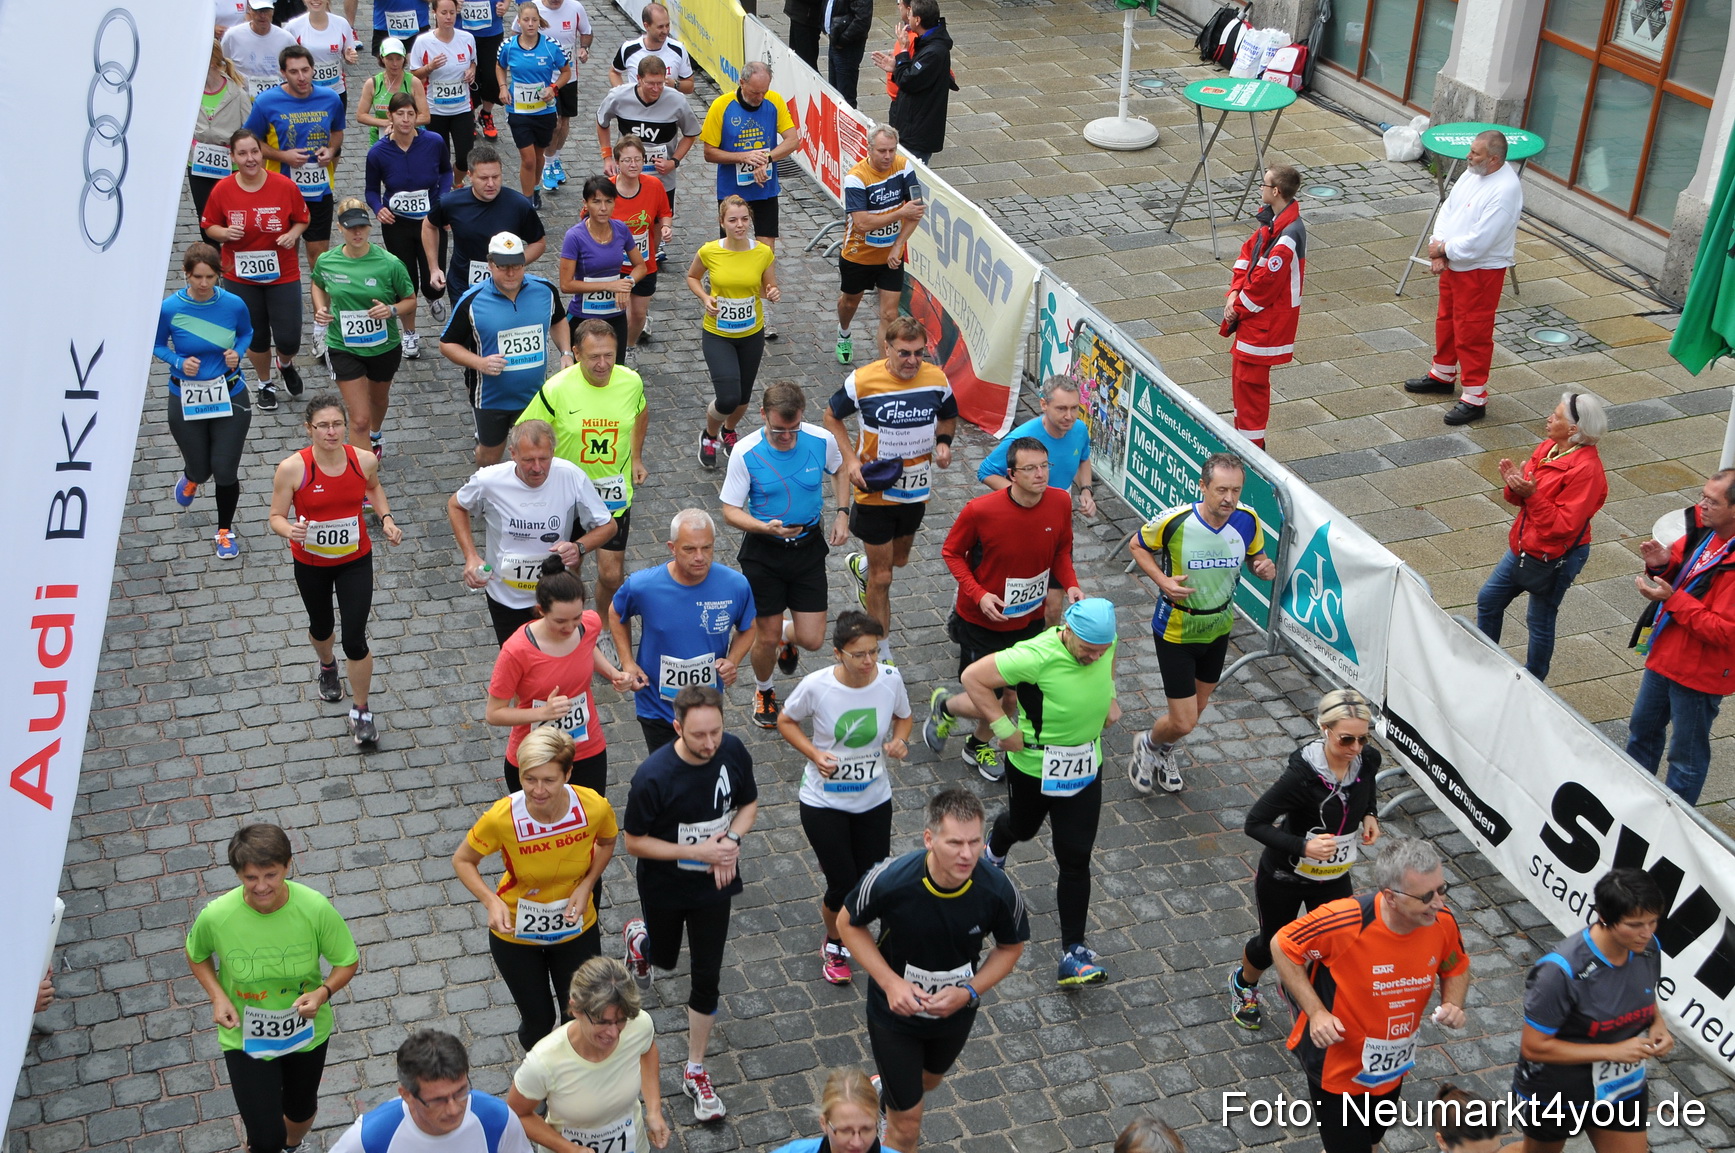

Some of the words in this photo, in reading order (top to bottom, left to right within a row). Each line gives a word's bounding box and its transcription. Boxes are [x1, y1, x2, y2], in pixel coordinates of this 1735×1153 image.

[464, 8, 489, 20] 3423
[390, 18, 414, 29] 2547
[313, 66, 338, 80] 2895
[437, 85, 463, 98] 2944
[520, 90, 540, 102] 174
[631, 123, 660, 142] sky
[197, 151, 229, 168] 2485
[295, 170, 326, 184] 2384
[394, 199, 426, 212] 2385
[240, 259, 275, 275] 2306
[721, 305, 752, 320] 2589
[910, 247, 990, 371] PFLASTERSTEINE
[347, 319, 382, 335] 2309
[504, 336, 541, 355] 2533
[510, 355, 538, 364] Bernhard
[185, 386, 222, 404] 2717
[194, 405, 220, 413] Daniela
[886, 400, 934, 420] Fischer
[582, 418, 620, 427] Müller
[590, 438, 609, 455] M
[899, 449, 911, 457] und
[1133, 425, 1165, 466] Mehr
[1166, 452, 1204, 503] Sicher
[892, 472, 928, 489] 175
[1131, 450, 1149, 480] für
[1150, 466, 1167, 496] Ihr
[1129, 485, 1145, 508] Miet
[1146, 500, 1153, 517] &
[509, 517, 546, 530] Allianz
[316, 529, 349, 545] 608
[1190, 549, 1224, 558] TEAM
[1187, 556, 1240, 570] BOCK
[10, 584, 79, 811] Audi
[45, 338, 106, 540] BKK
[1010, 580, 1044, 605] 2523
[1283, 617, 1313, 646] Gebäude
[1312, 639, 1338, 664] Service
[1337, 658, 1360, 682] GmbH
[661, 660, 679, 669] PARTL
[680, 660, 707, 669] Neumarkt
[665, 666, 712, 687] 2068
[538, 706, 585, 730] 359
[829, 759, 877, 781] 2257
[1048, 755, 1092, 777] 2741
[1055, 780, 1085, 790] Andreas
[1431, 762, 1448, 785] die
[1448, 778, 1497, 836] verbinden
[519, 842, 552, 855] MAX
[555, 831, 590, 849] BÖGL
[519, 903, 541, 913] PARTL
[906, 970, 929, 981] PARTL
[930, 974, 964, 983] Neumarkt
[1372, 973, 1432, 991] SportScheck
[245, 1010, 269, 1019] PARTL
[251, 1014, 308, 1038] 3394
[1390, 1021, 1412, 1036] GfK
[1365, 1043, 1389, 1051] PARTL
[563, 1128, 588, 1139] PARTL
[590, 1124, 624, 1140] Neumarkt
